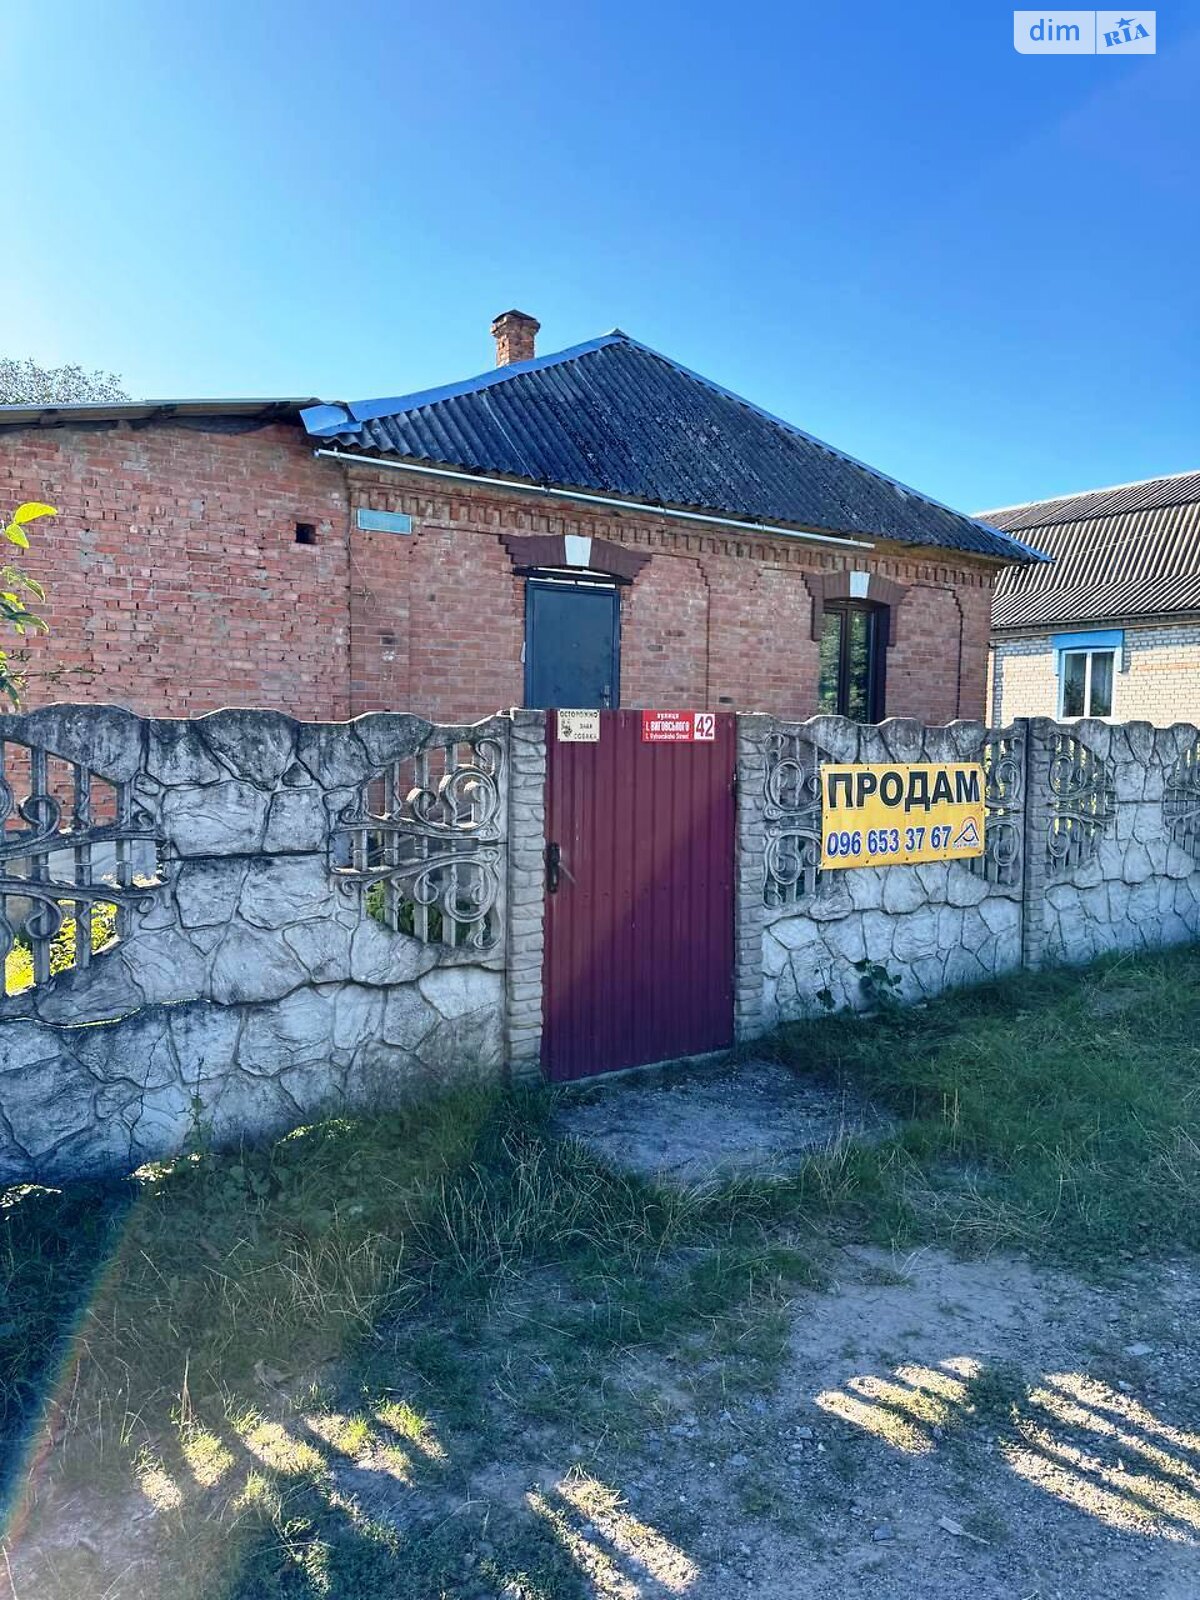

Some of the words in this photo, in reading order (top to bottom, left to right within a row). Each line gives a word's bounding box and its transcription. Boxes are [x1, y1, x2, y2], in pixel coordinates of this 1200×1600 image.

[560, 710, 598, 718] ОСТОРОЖНО
[695, 715, 713, 737] 42
[828, 770, 980, 812] ПРОДАМ
[827, 831, 861, 856] 096
[868, 829, 899, 853] 653
[905, 827, 926, 850] 37
[931, 825, 952, 848] 67
